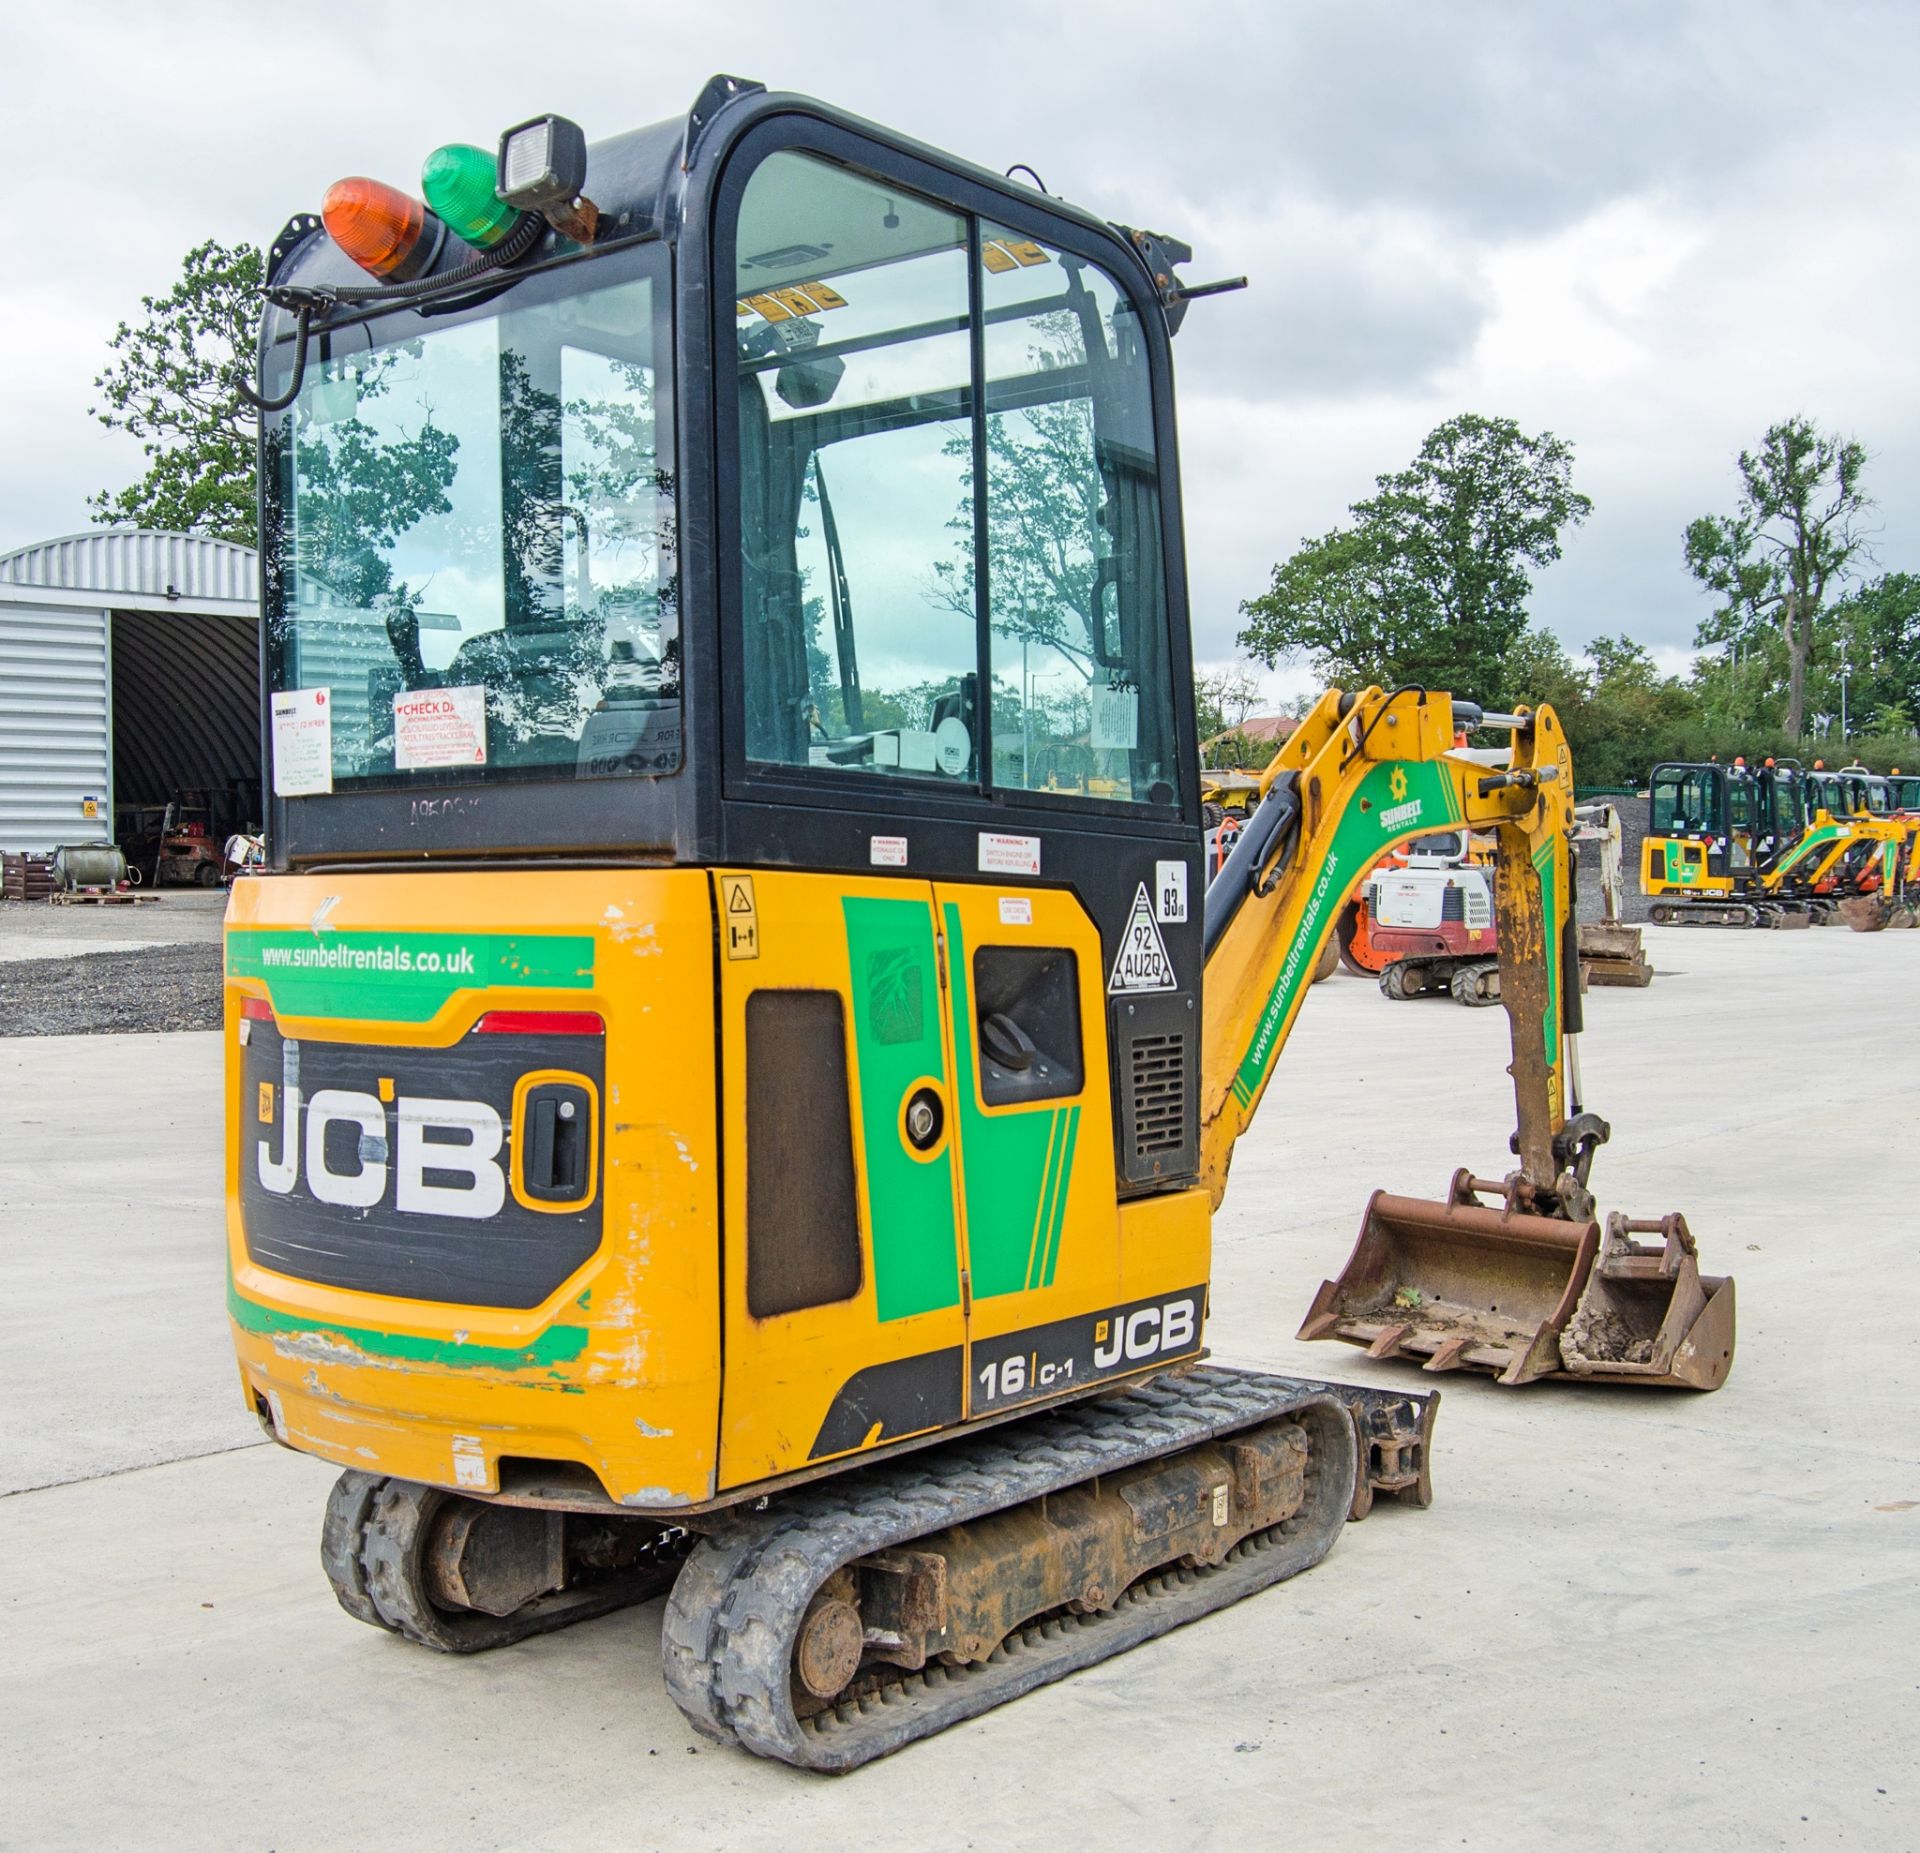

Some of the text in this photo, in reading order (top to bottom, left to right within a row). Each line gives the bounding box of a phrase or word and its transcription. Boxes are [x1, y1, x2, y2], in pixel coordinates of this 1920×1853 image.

[403, 702, 440, 715] CHECK
[1380, 799, 1422, 828] SUNBELT
[1387, 816, 1417, 832] RENTALS
[1171, 871, 1176, 881] L
[1164, 888, 1178, 917] 93
[1134, 926, 1152, 951] 92
[262, 943, 475, 974] www.sunbeltrentals.co.uk
[1125, 953, 1161, 977] AU2Q
[1251, 851, 1339, 1065] www.sunbeltrentals.co.uk
[257, 1040, 506, 1219] JCB
[1094, 1299, 1195, 1369] JCB
[979, 1355, 1026, 1400] 16
